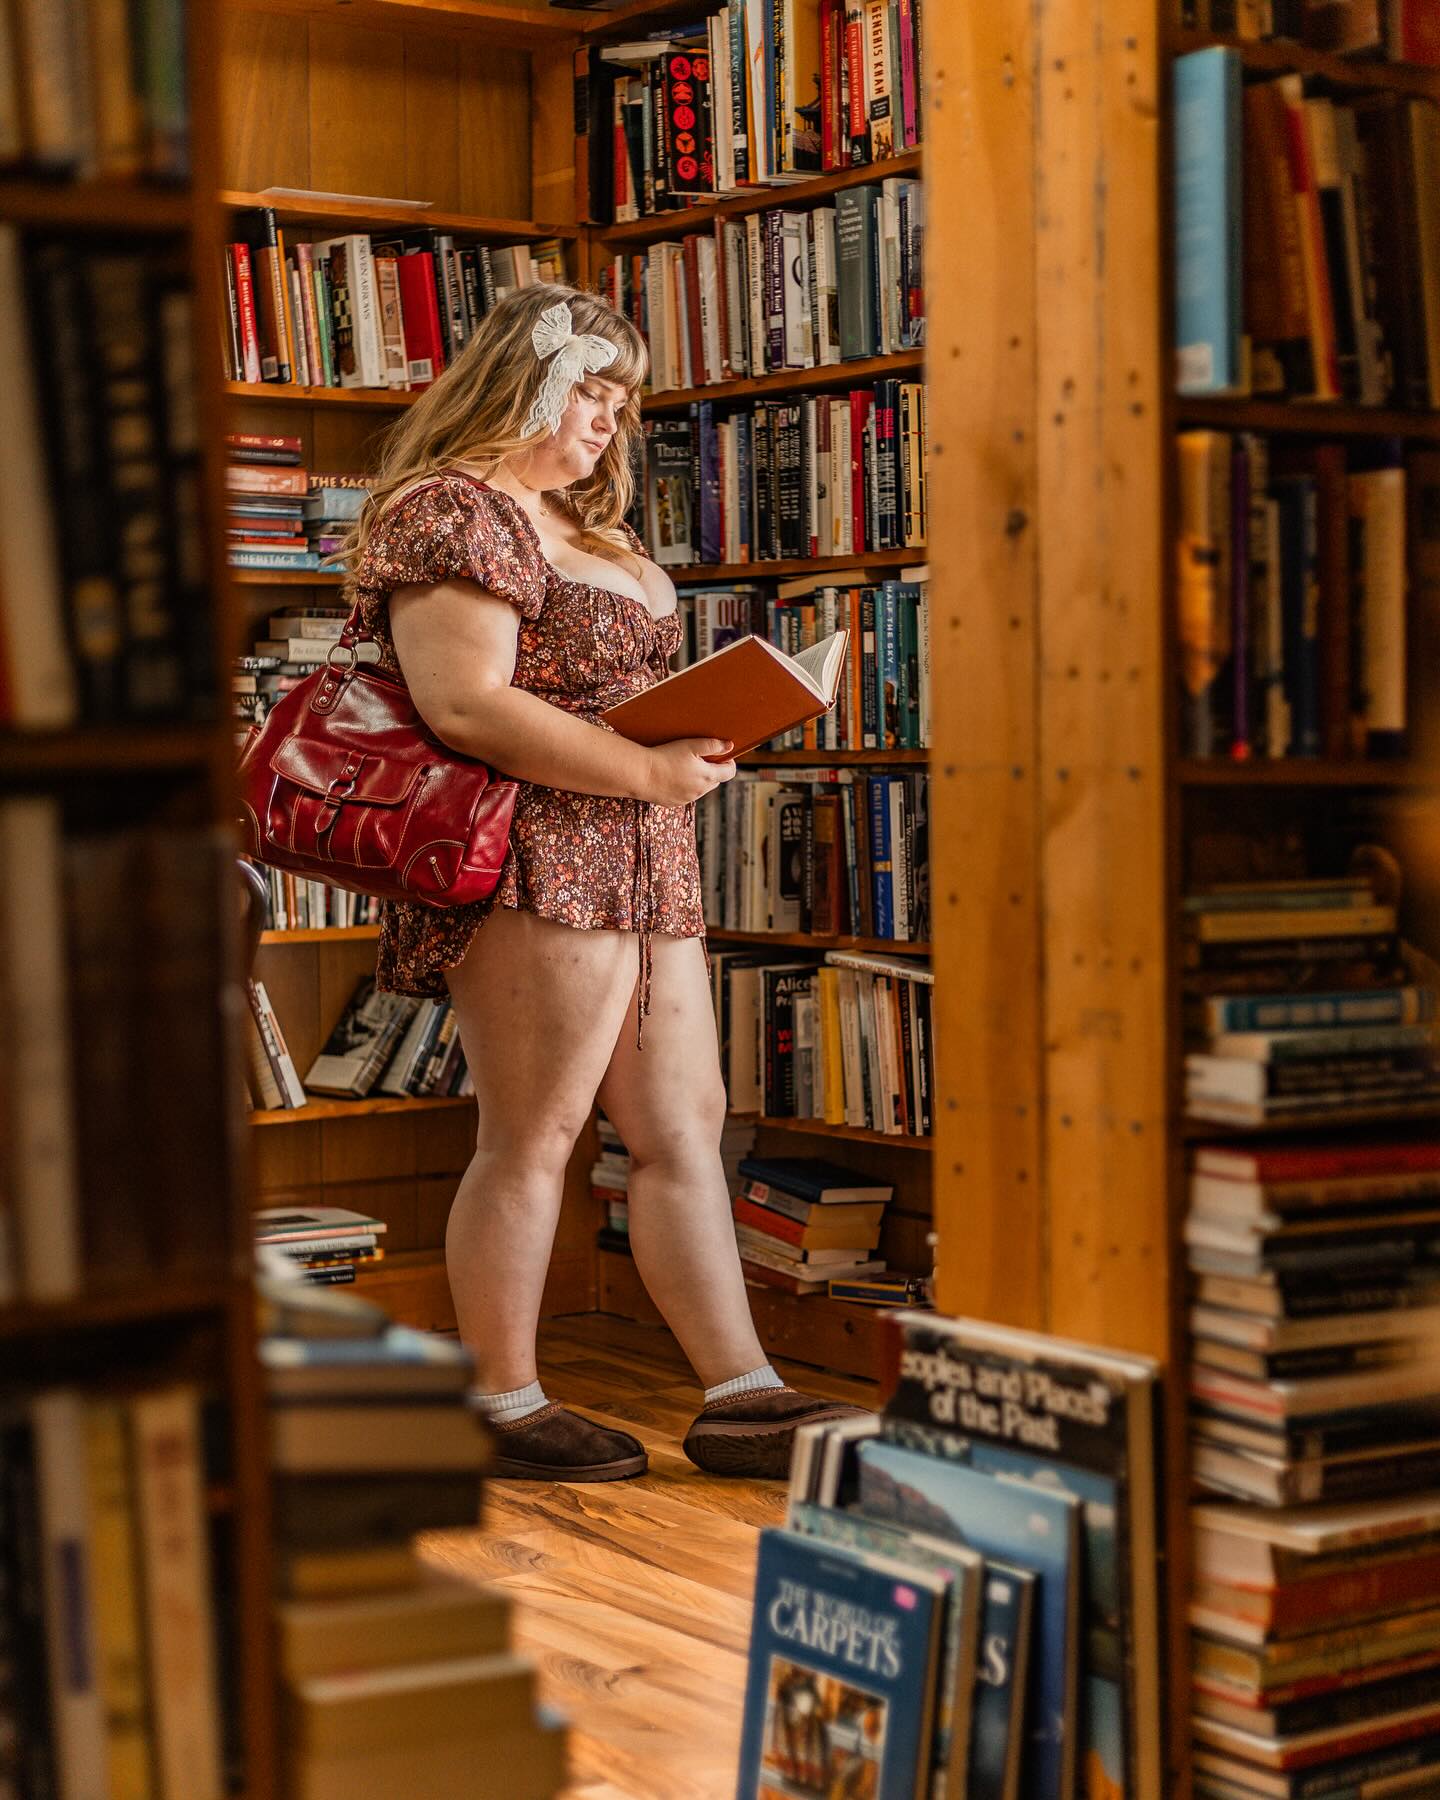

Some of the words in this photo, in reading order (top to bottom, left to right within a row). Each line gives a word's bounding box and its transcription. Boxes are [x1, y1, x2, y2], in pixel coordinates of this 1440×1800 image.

[728, 17, 739, 34] THE
[851, 28, 858, 37] IN
[872, 6, 885, 57] GENGHIS
[729, 38, 740, 72] HEART
[824, 66, 832, 76] OF
[874, 62, 886, 95] KHAN
[730, 85, 740, 103] THE
[824, 78, 832, 97] FIVE
[852, 85, 859, 95] OF
[852, 97, 860, 129] EMPIRE
[731, 105, 742, 156] DRAGN
[772, 214, 781, 233] The
[359, 244, 369, 275] SEVEN
[771, 235, 782, 275] Courage
[480, 246, 497, 311] MEDICINEMAK
[774, 277, 782, 287] to
[361, 276, 371, 320] ARROWS
[774, 289, 783, 312] Heal
[882, 407, 895, 439] SUSAN
[309, 475, 337, 488] THE
[339, 476, 379, 489] SACRE
[877, 452, 896, 516] BACKLASH
[240, 554, 297, 565] HERITAGE
[886, 585, 894, 615] HALF
[874, 814, 884, 857] ROBERTS
[776, 976, 810, 992] Alice
[975, 1366, 1021, 1402] and
[930, 1388, 956, 1424] of
[957, 1391, 1000, 1434] the
[1001, 1402, 1062, 1450] Past
[769, 1599, 903, 1680] CARPETS
